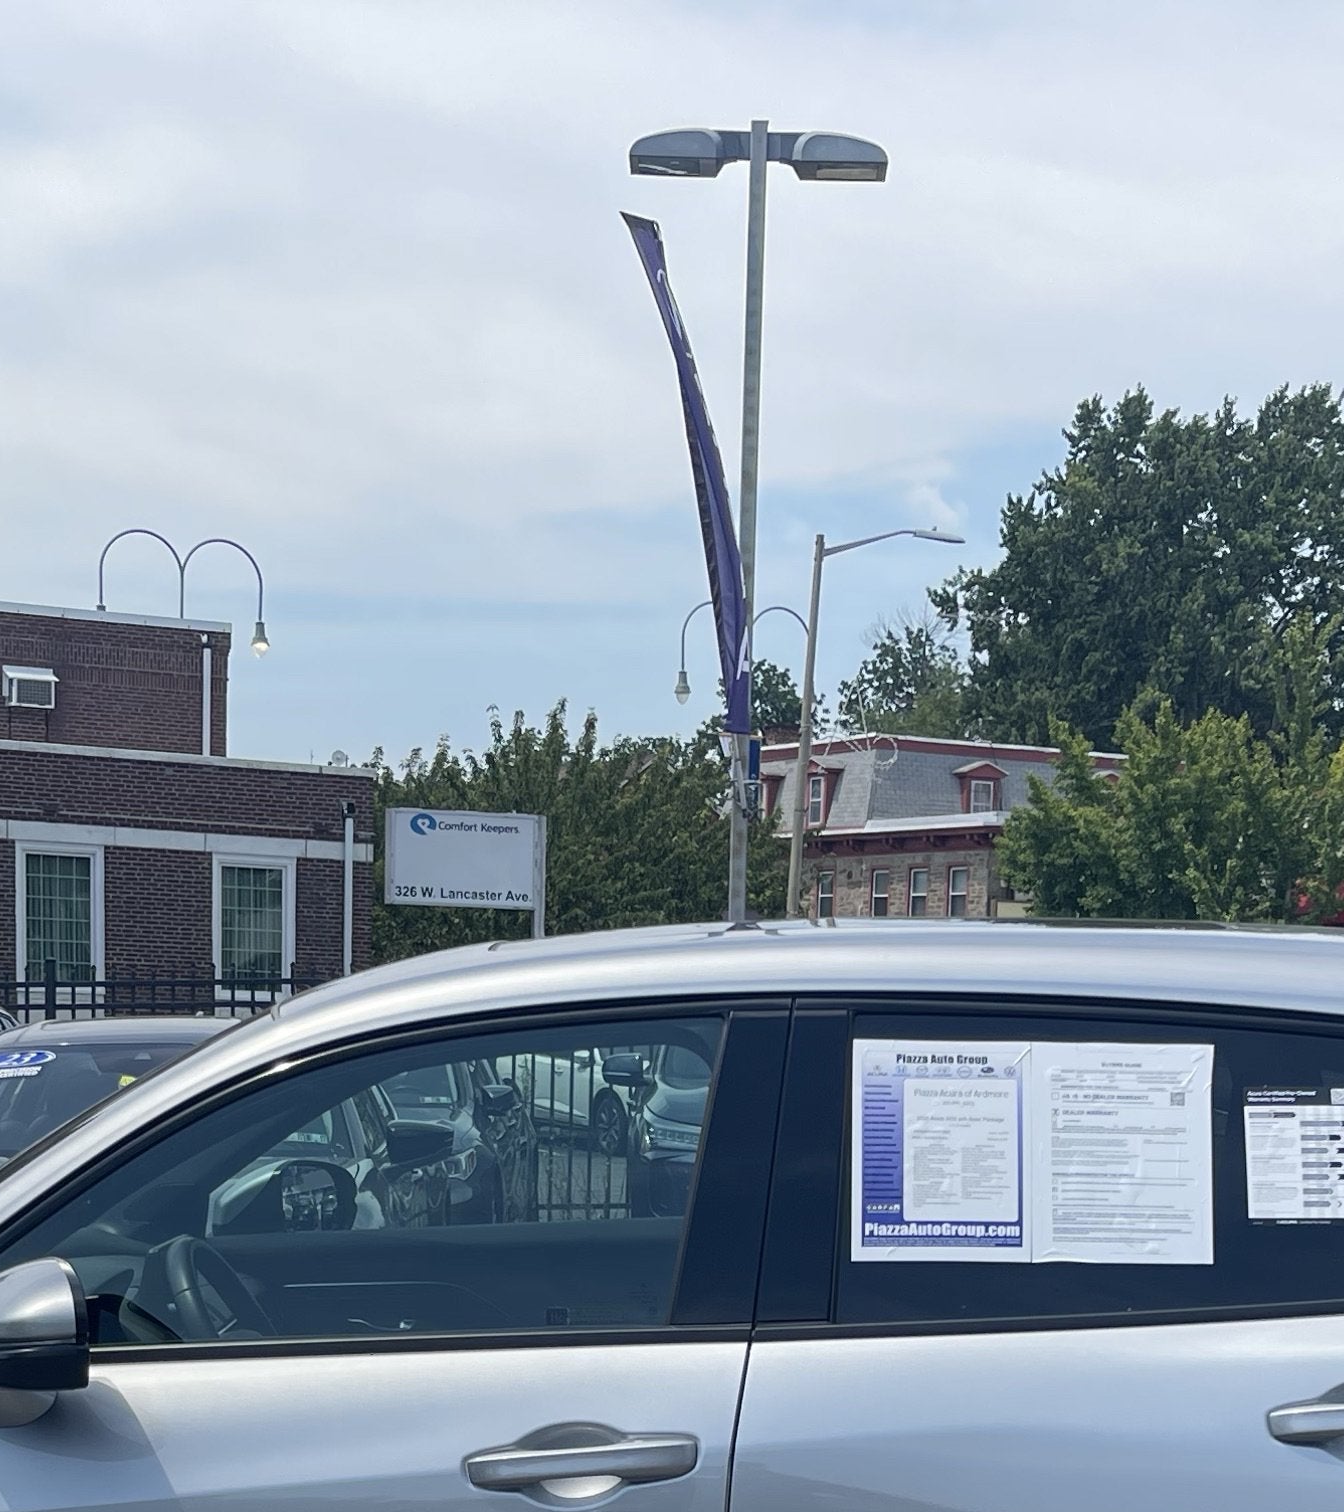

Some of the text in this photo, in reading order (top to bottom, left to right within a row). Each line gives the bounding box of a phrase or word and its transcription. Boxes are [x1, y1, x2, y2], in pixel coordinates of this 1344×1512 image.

[438, 820, 519, 835] Comfort Keepers
[394, 886, 418, 898] 326
[440, 887, 503, 902] Lancaster
[505, 890, 532, 903] Ave.
[896, 1053, 989, 1066] Piazza Auto Group
[864, 1222, 1021, 1238] PiazzaAutoGroup.com
